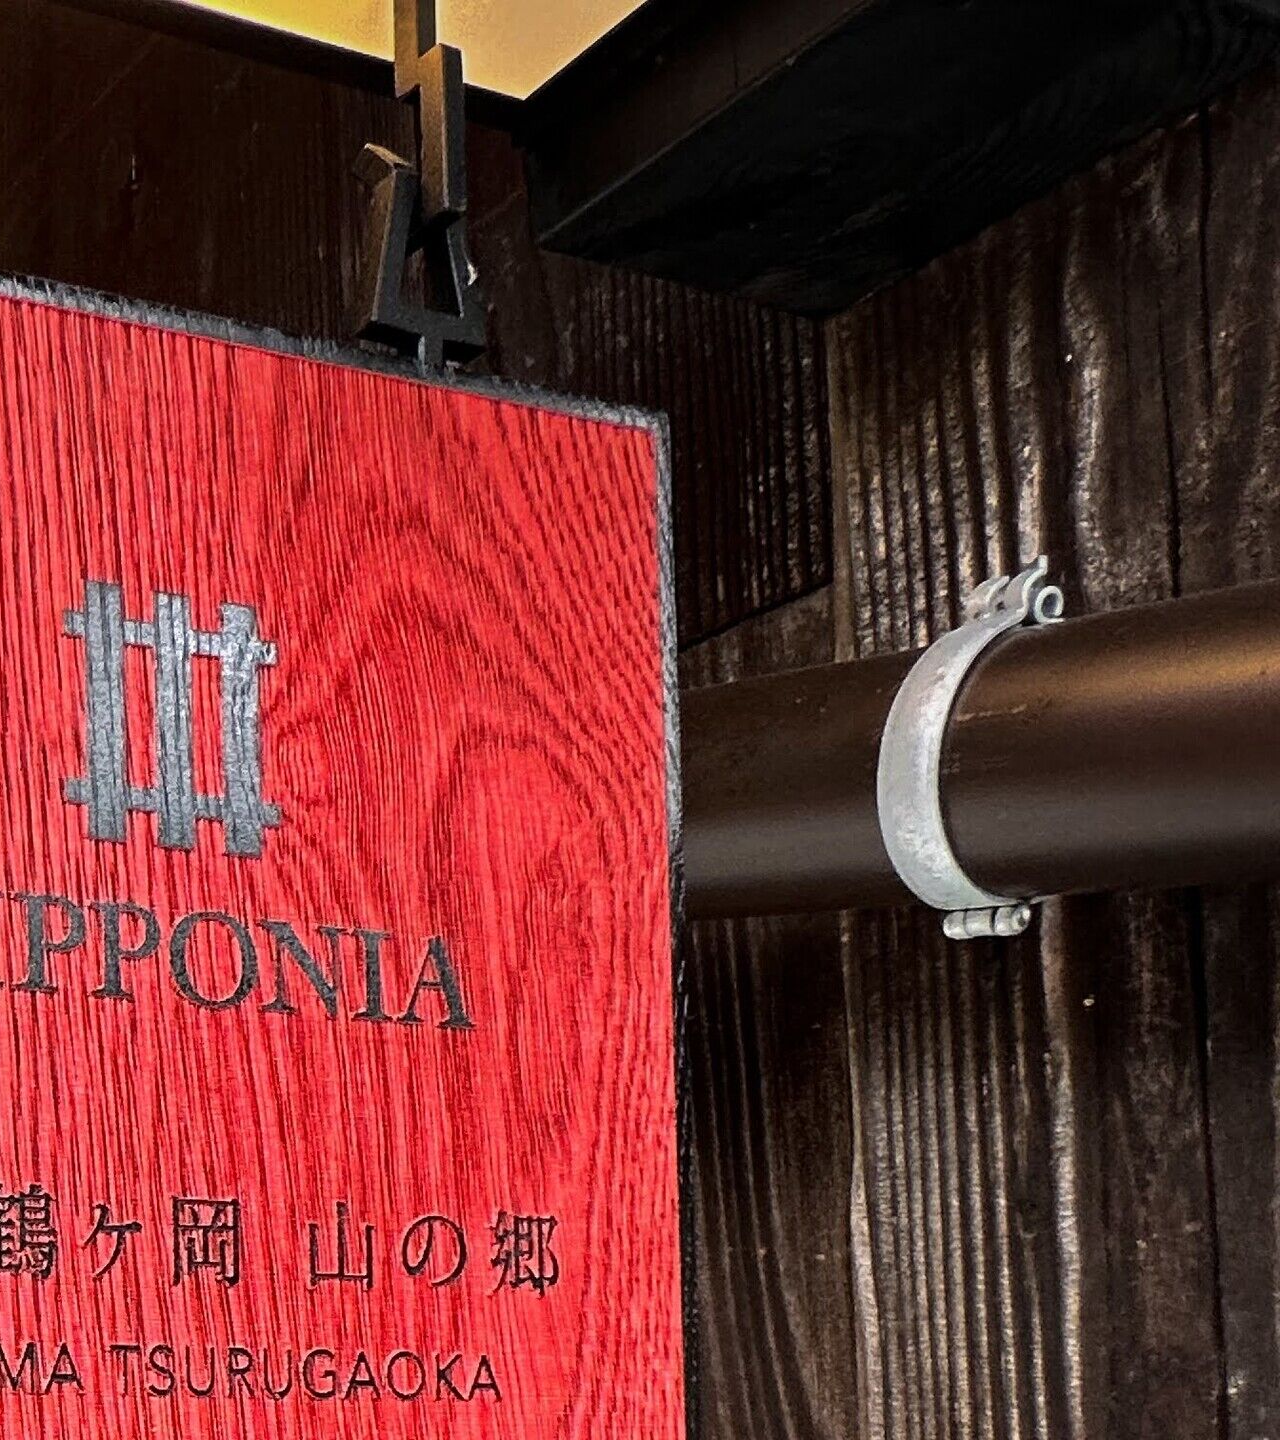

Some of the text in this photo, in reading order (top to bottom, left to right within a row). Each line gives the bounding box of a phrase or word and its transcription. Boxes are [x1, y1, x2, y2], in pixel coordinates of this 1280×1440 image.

[309, 1200, 560, 1298] 山の郷
[110, 1343, 501, 1401] TSURUGAOKA
